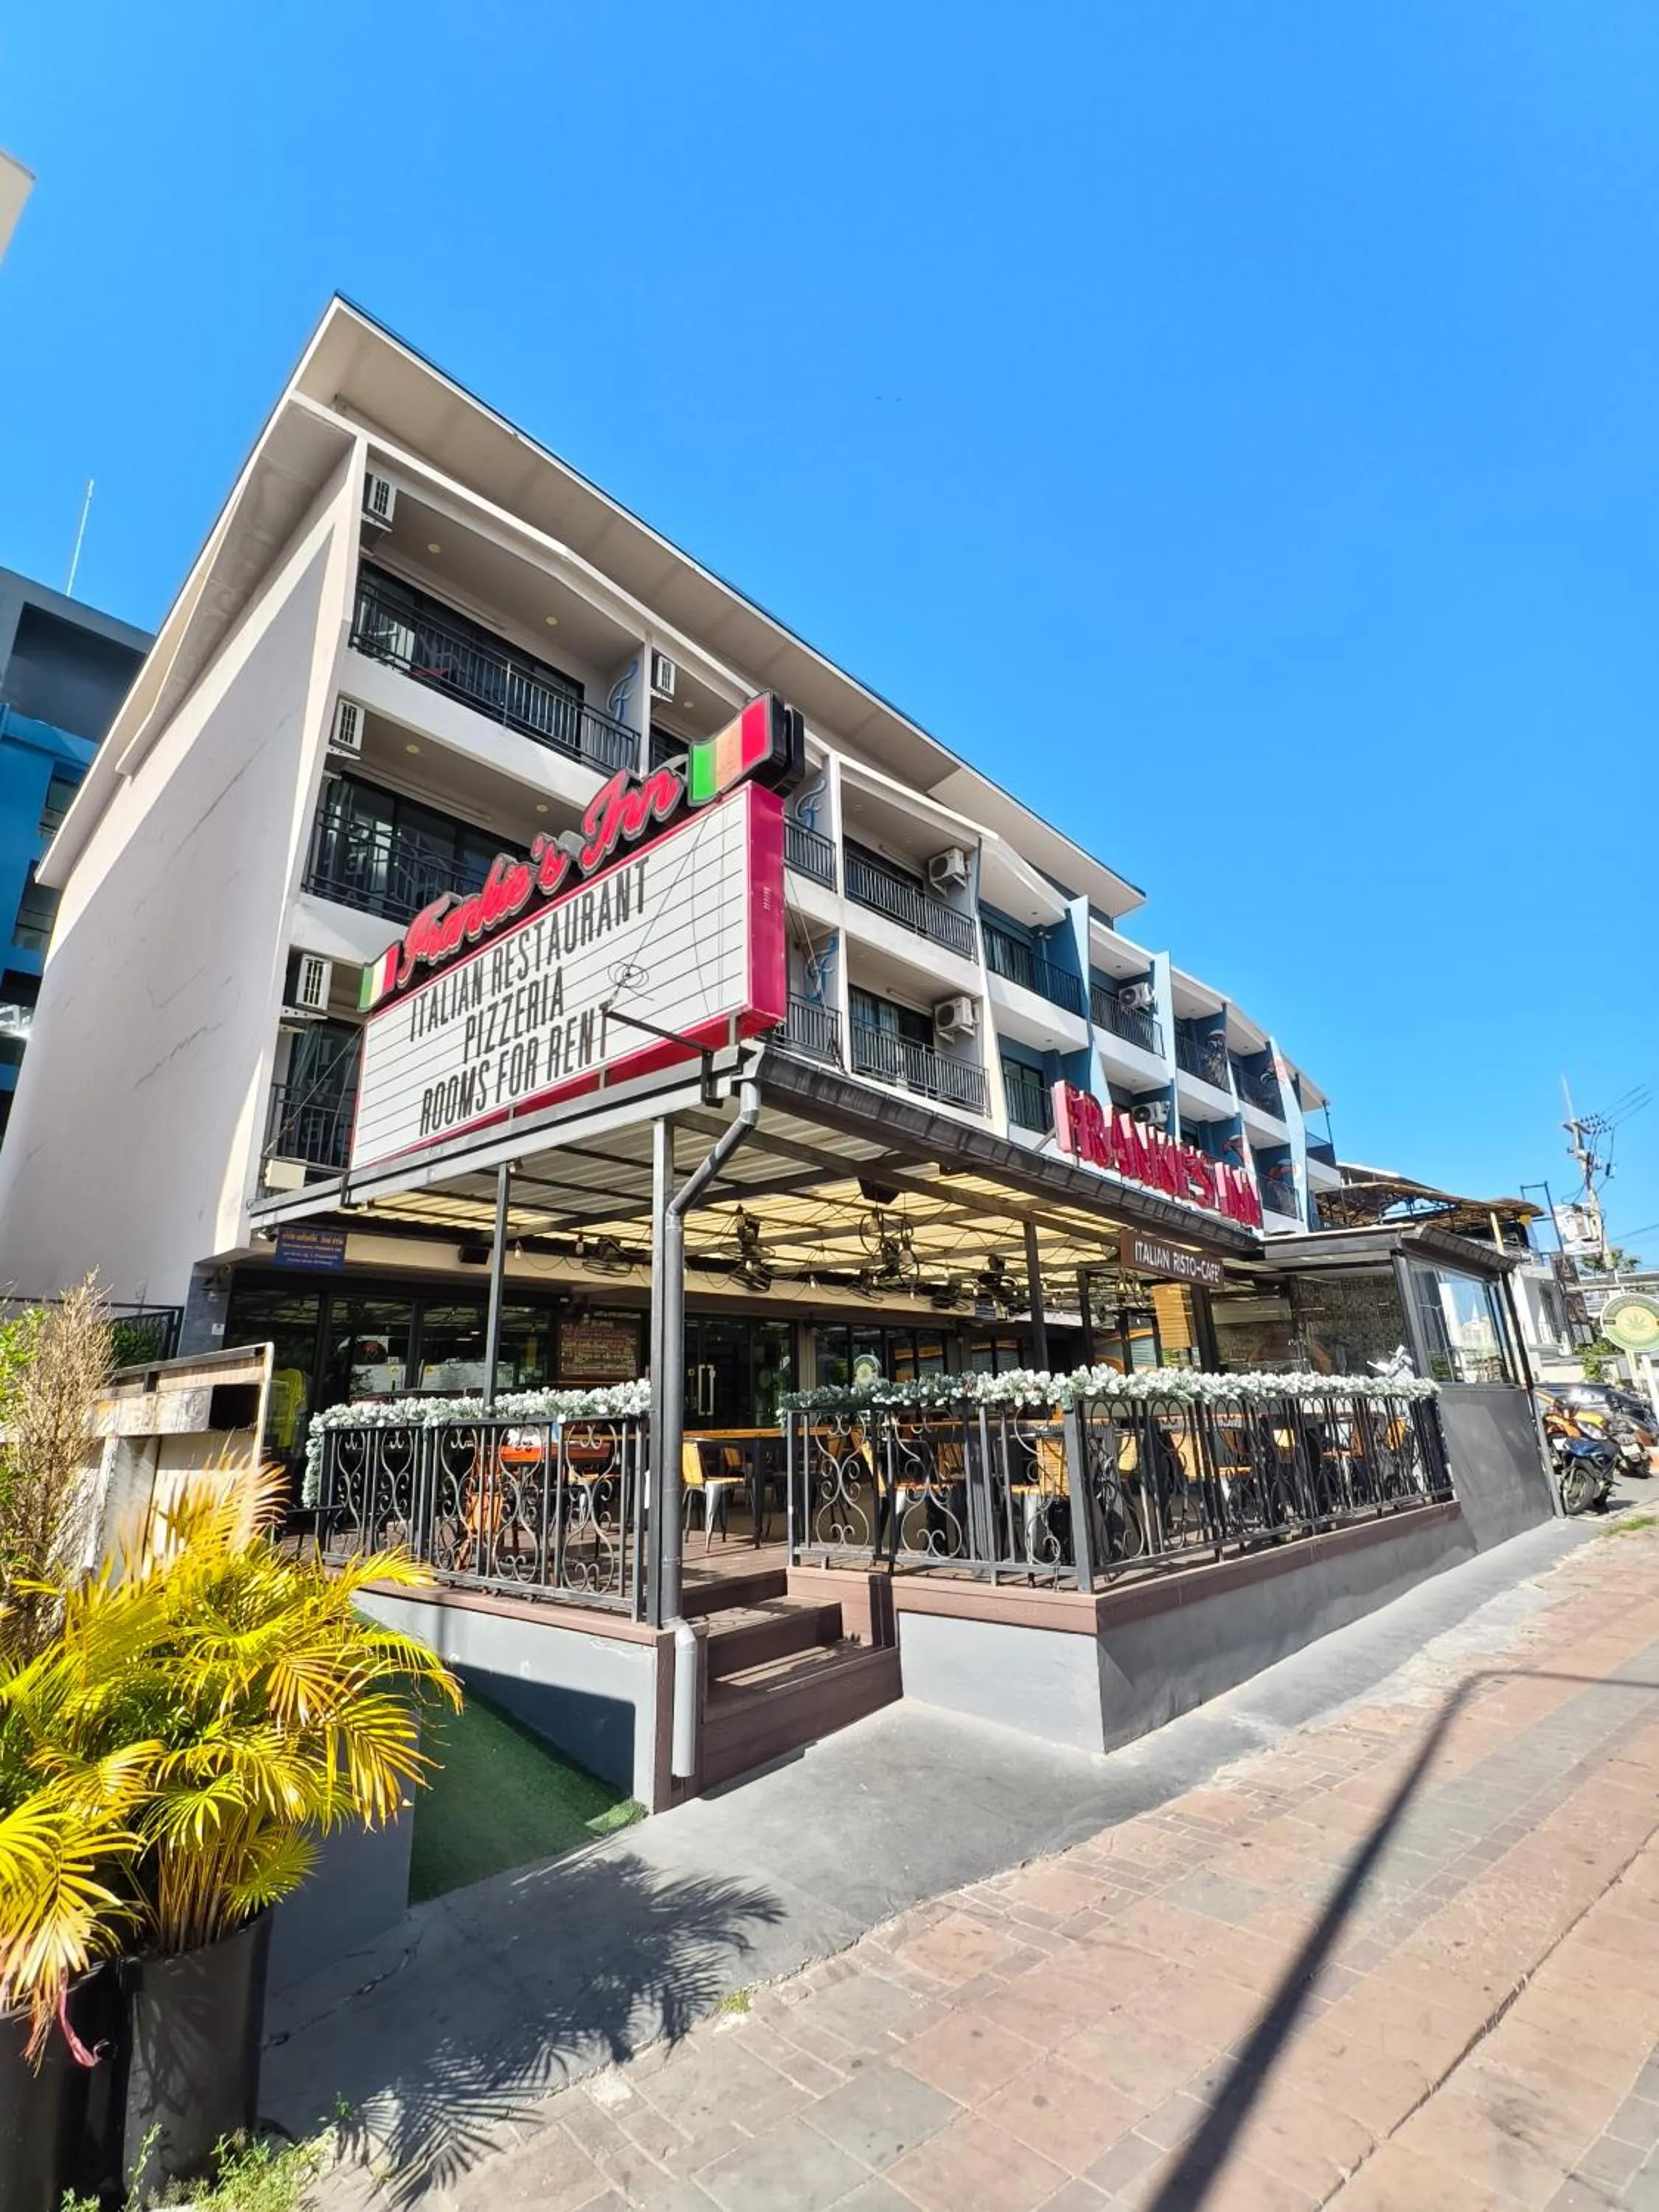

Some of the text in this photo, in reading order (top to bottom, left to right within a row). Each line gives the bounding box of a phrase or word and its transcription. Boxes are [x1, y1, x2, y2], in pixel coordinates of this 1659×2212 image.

[578, 767, 684, 877] Inn
[410, 856, 650, 1042] ITALIAN RESTAURANT
[420, 1000, 609, 1137] ROOMS FOR RENT
[463, 966, 564, 1064] PIZZERIA
[1135, 1239, 1171, 1270] ITALIAN
